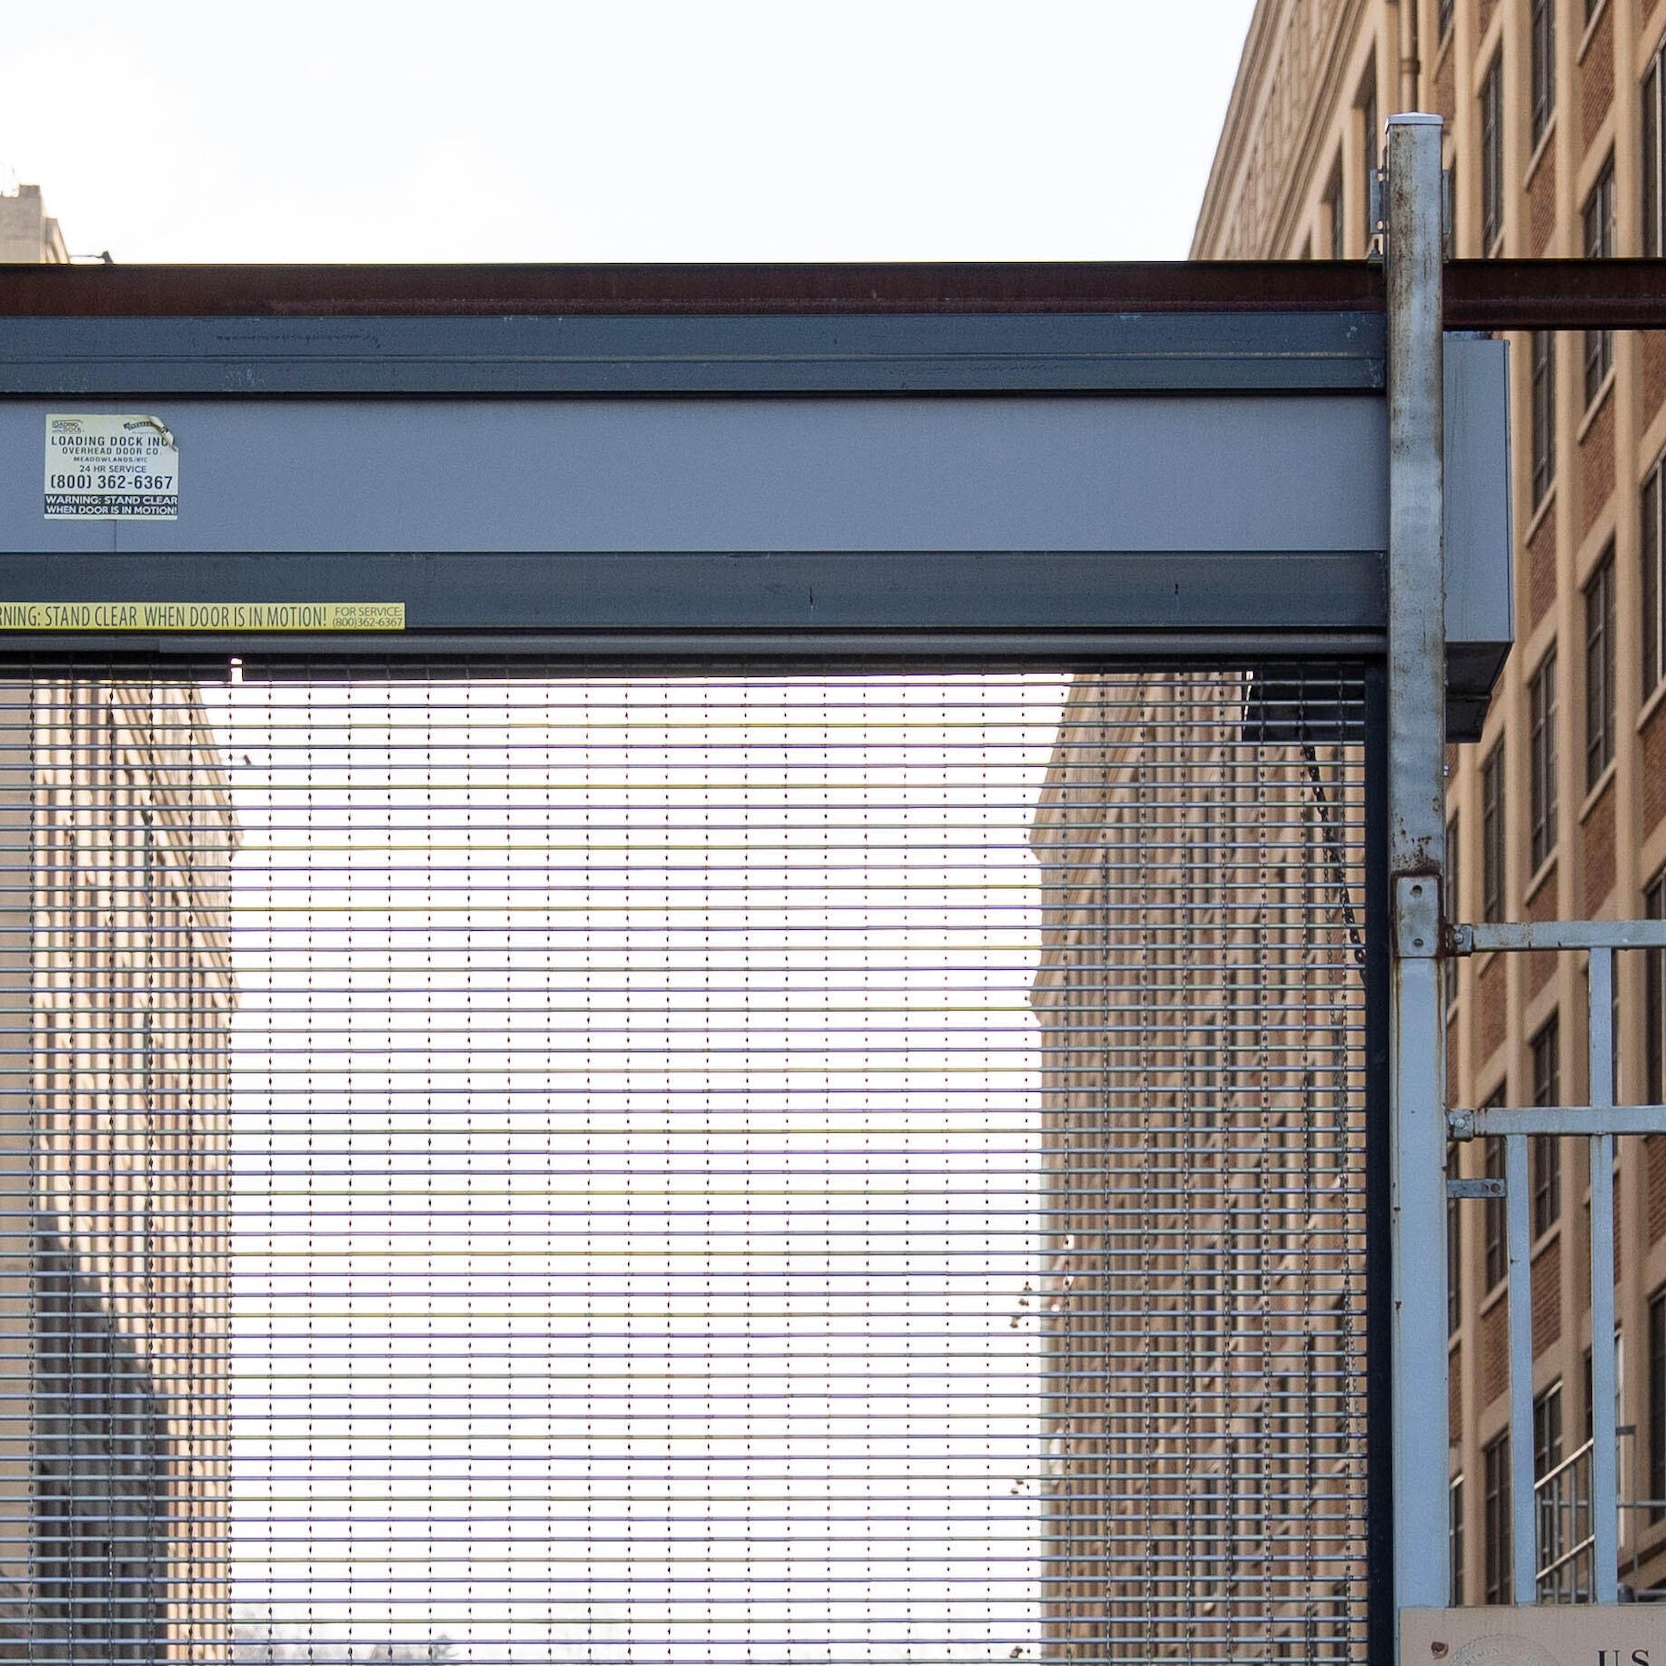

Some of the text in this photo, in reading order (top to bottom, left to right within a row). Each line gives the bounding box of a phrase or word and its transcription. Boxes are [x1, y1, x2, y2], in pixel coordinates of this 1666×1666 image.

[51, 436, 105, 446] LOADING
[110, 436, 143, 446] DOCK
[62, 447, 112, 455] OVERHEAD
[116, 447, 142, 455] DOOR
[79, 465, 147, 473] 24 HR SERVICE
[51, 474, 173, 489] (800) 362-6367
[45, 495, 178, 504] WARNING: STAND CLEAR
[46, 505, 177, 514] WHEN DOOR IS IN MOTION!
[335, 607, 355, 616] FOR
[45, 606, 90, 627] STAND
[94, 606, 138, 627] CLEAR
[144, 606, 184, 627] WHEN
[190, 606, 230, 627] DOOR
[234, 606, 245, 627] IS
[249, 606, 263, 627] IN
[267, 606, 327, 627] MOTION!
[332, 617, 403, 628] (800)362-6367
